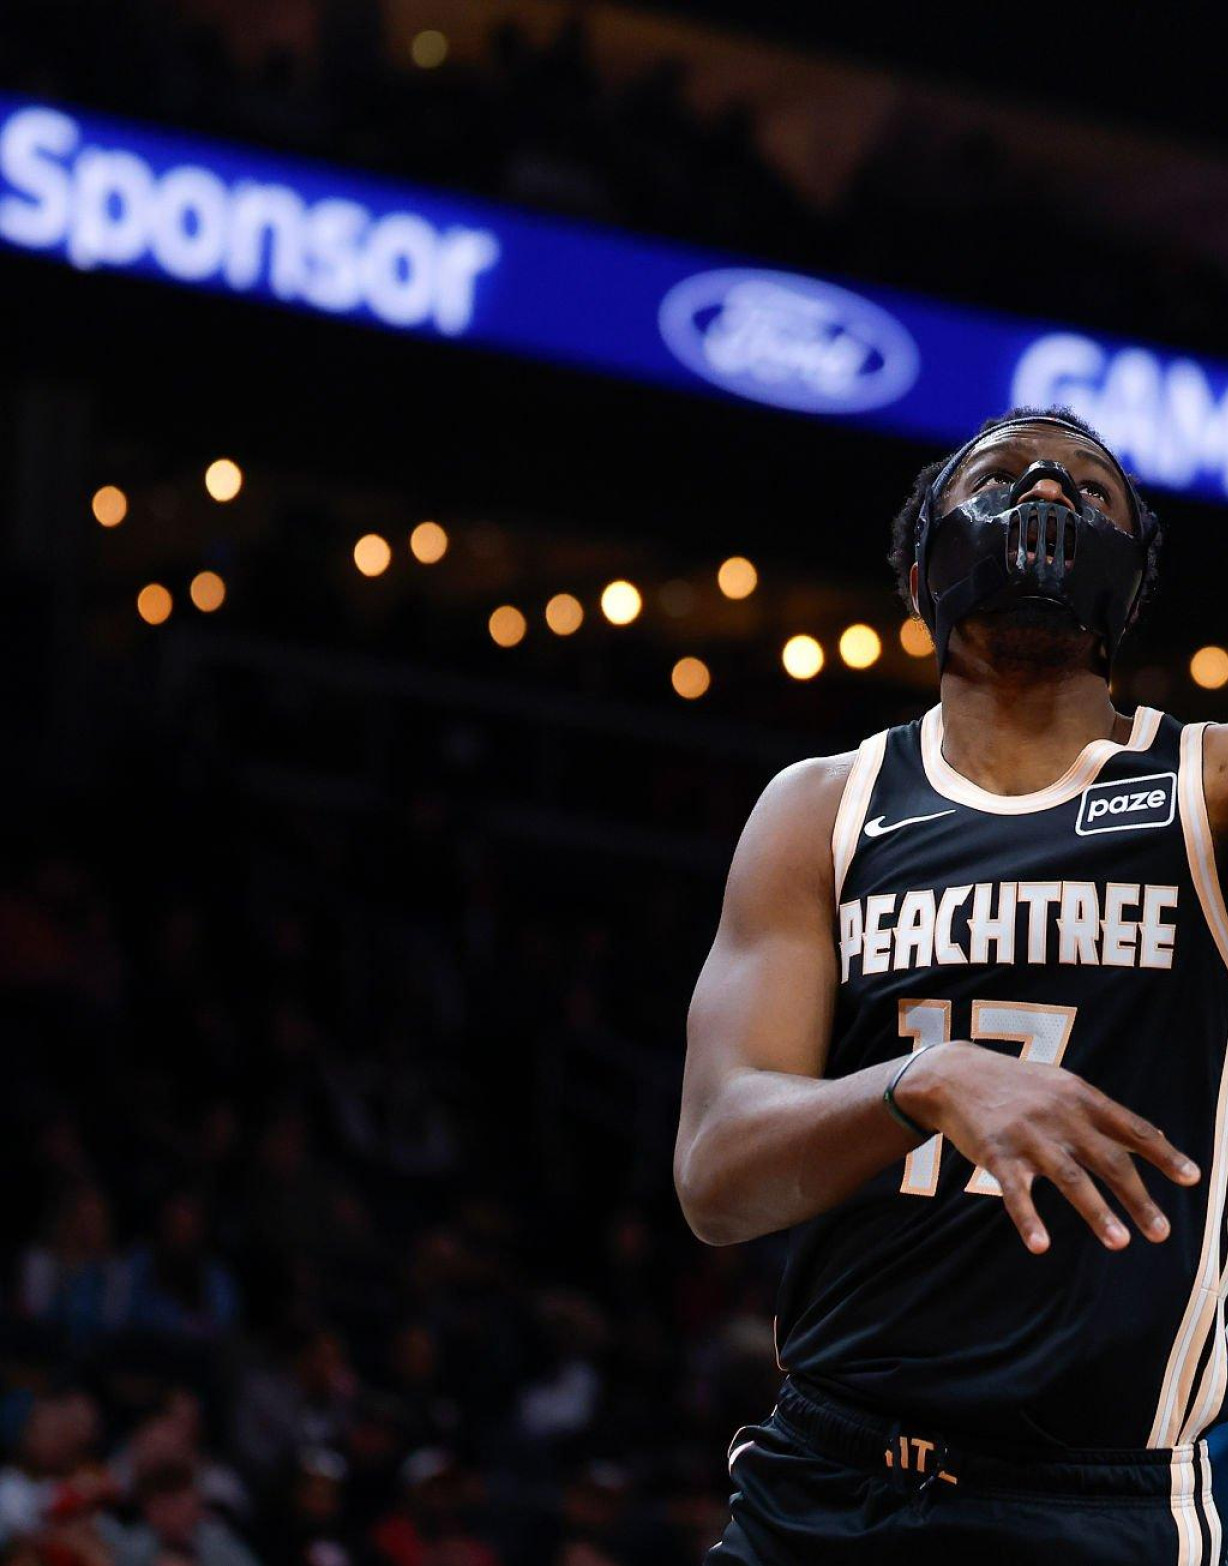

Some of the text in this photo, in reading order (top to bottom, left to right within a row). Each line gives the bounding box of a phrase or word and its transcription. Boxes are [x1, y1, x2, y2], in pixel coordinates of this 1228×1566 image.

[0, 105, 502, 338] Sponsor
[1086, 788, 1167, 823] paze
[839, 880, 1179, 984] PEACHTREE
